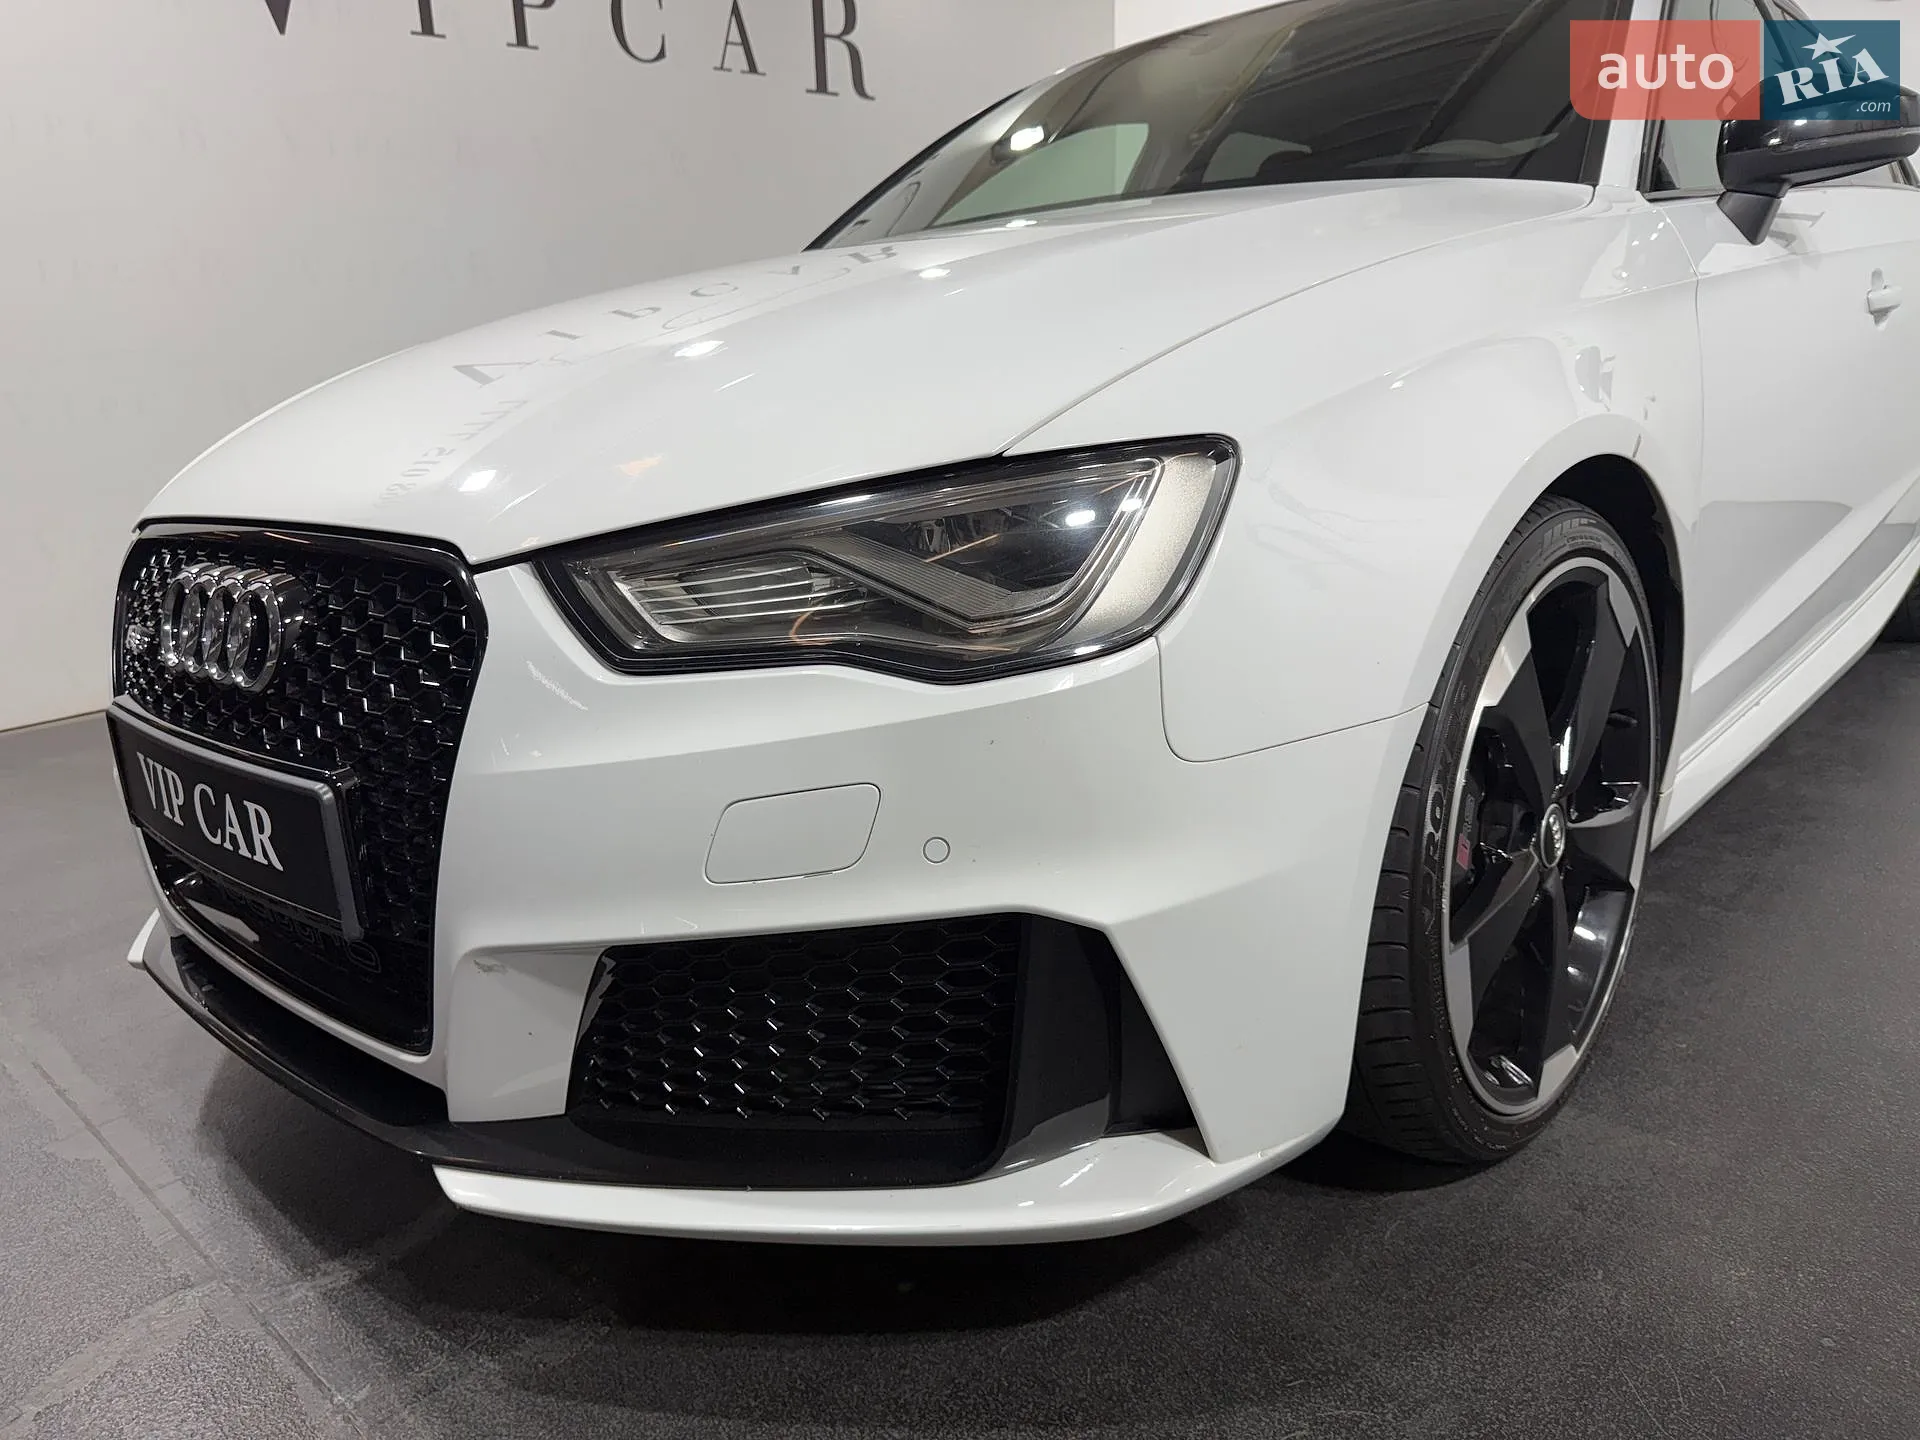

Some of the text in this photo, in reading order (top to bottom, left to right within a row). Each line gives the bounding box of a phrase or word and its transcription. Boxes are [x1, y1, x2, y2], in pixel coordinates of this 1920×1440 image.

[263, 0, 876, 101] PCAR
[136, 751, 284, 872] VIP CAR
